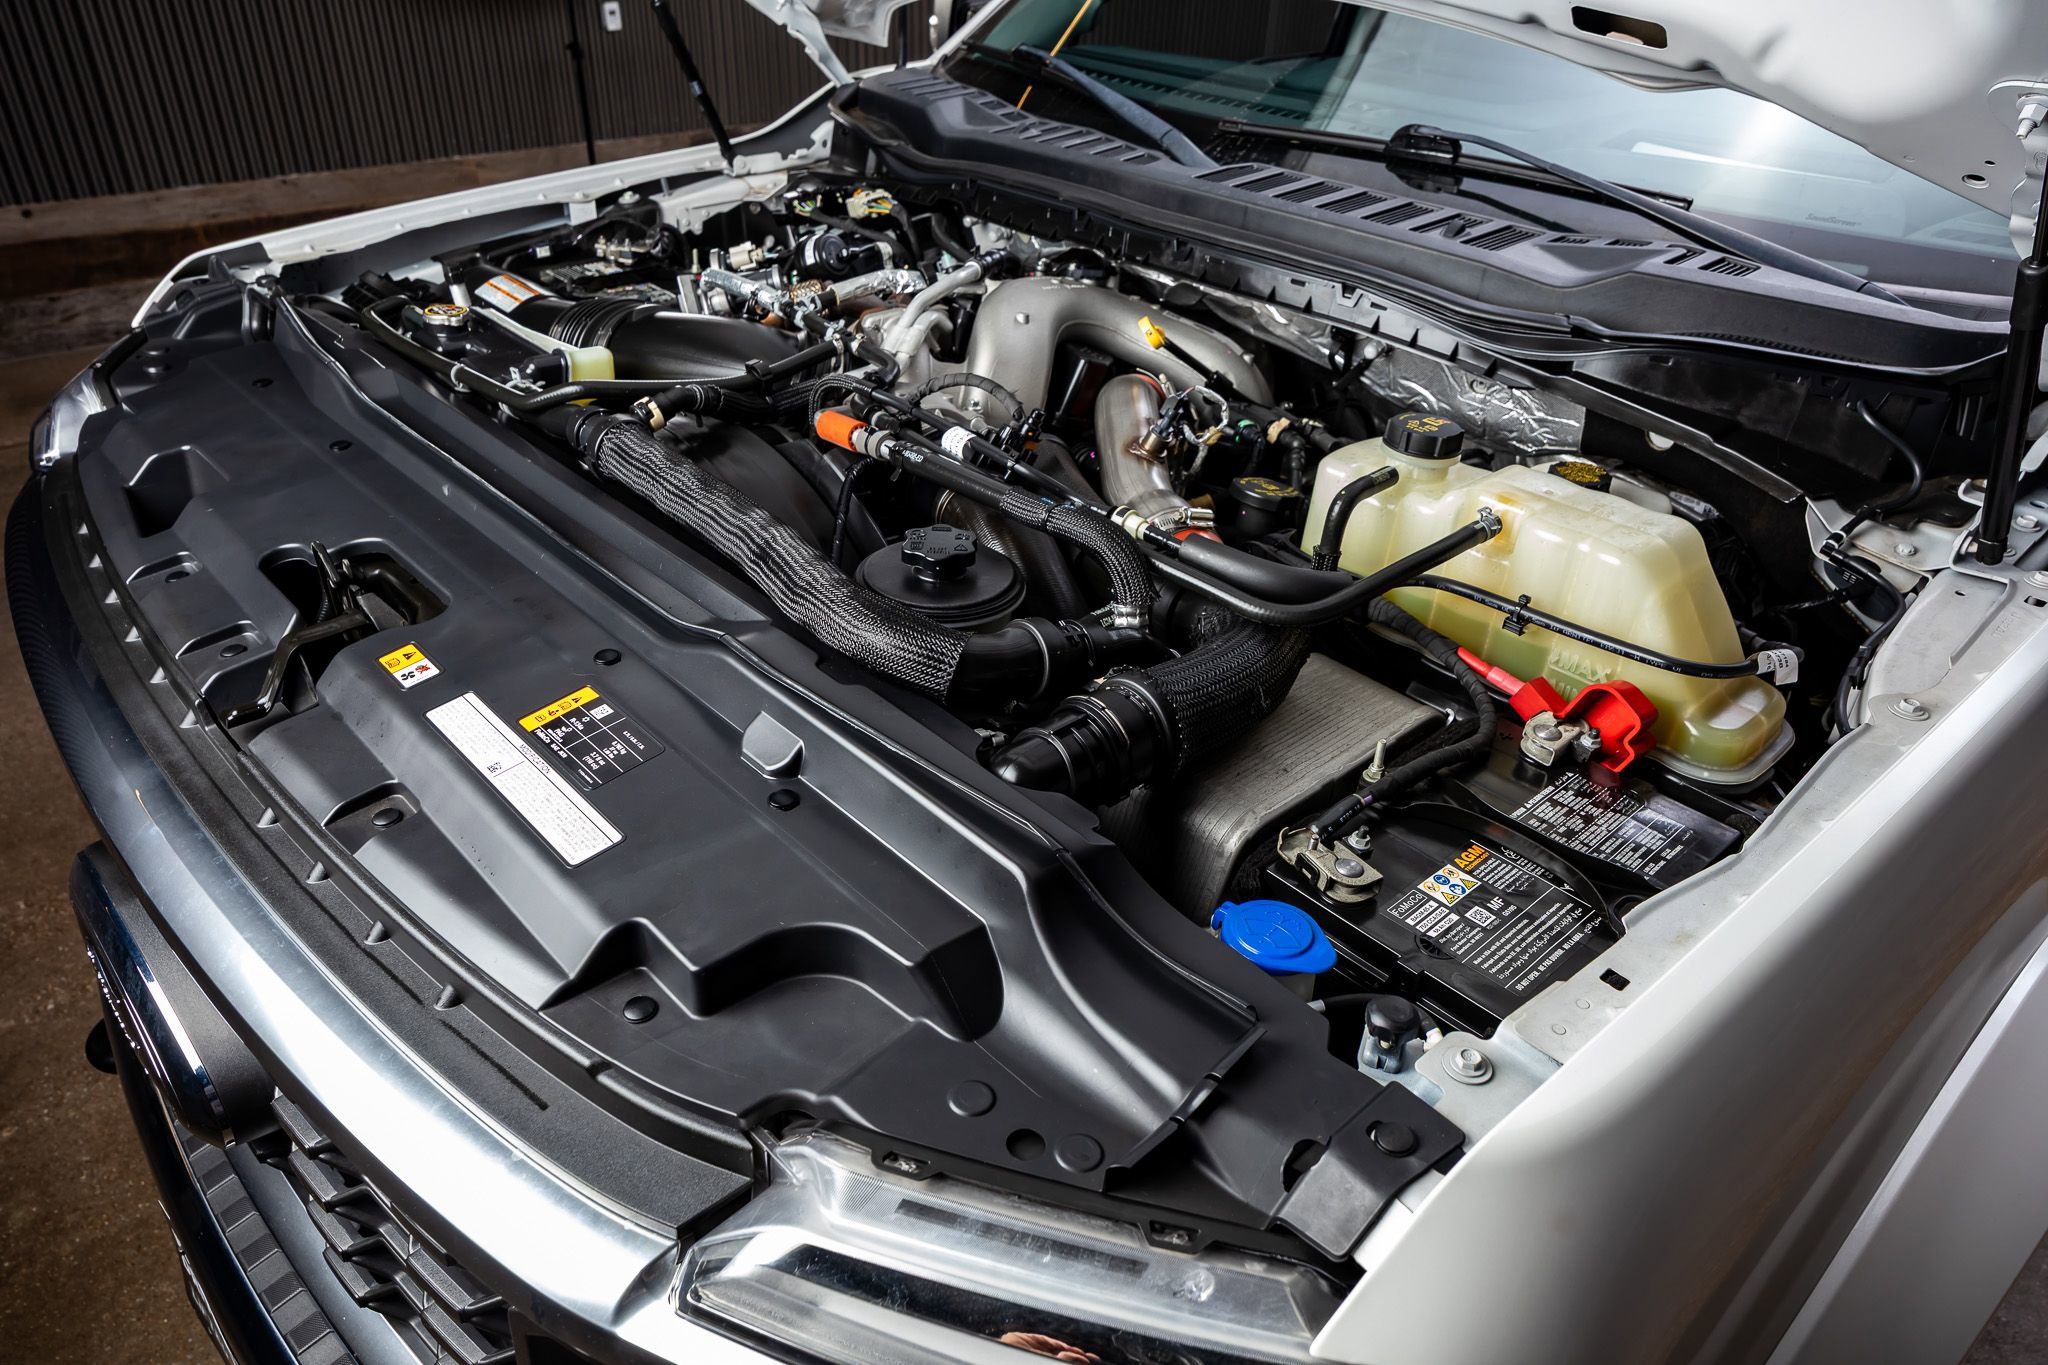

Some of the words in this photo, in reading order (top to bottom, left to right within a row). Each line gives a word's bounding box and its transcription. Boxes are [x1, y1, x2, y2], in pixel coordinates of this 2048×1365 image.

[1556, 650, 1611, 684] MAX
[517, 743, 553, 774] MODIFICATION
[1451, 843, 1485, 868] AGM
[1391, 891, 1424, 916] FoMoCo
[1485, 895, 1507, 910] MF
[1541, 958, 1553, 967] PAS
[1519, 977, 1532, 986] NOT
[1525, 969, 1542, 981] OPEN.
[1513, 983, 1525, 991] DO
